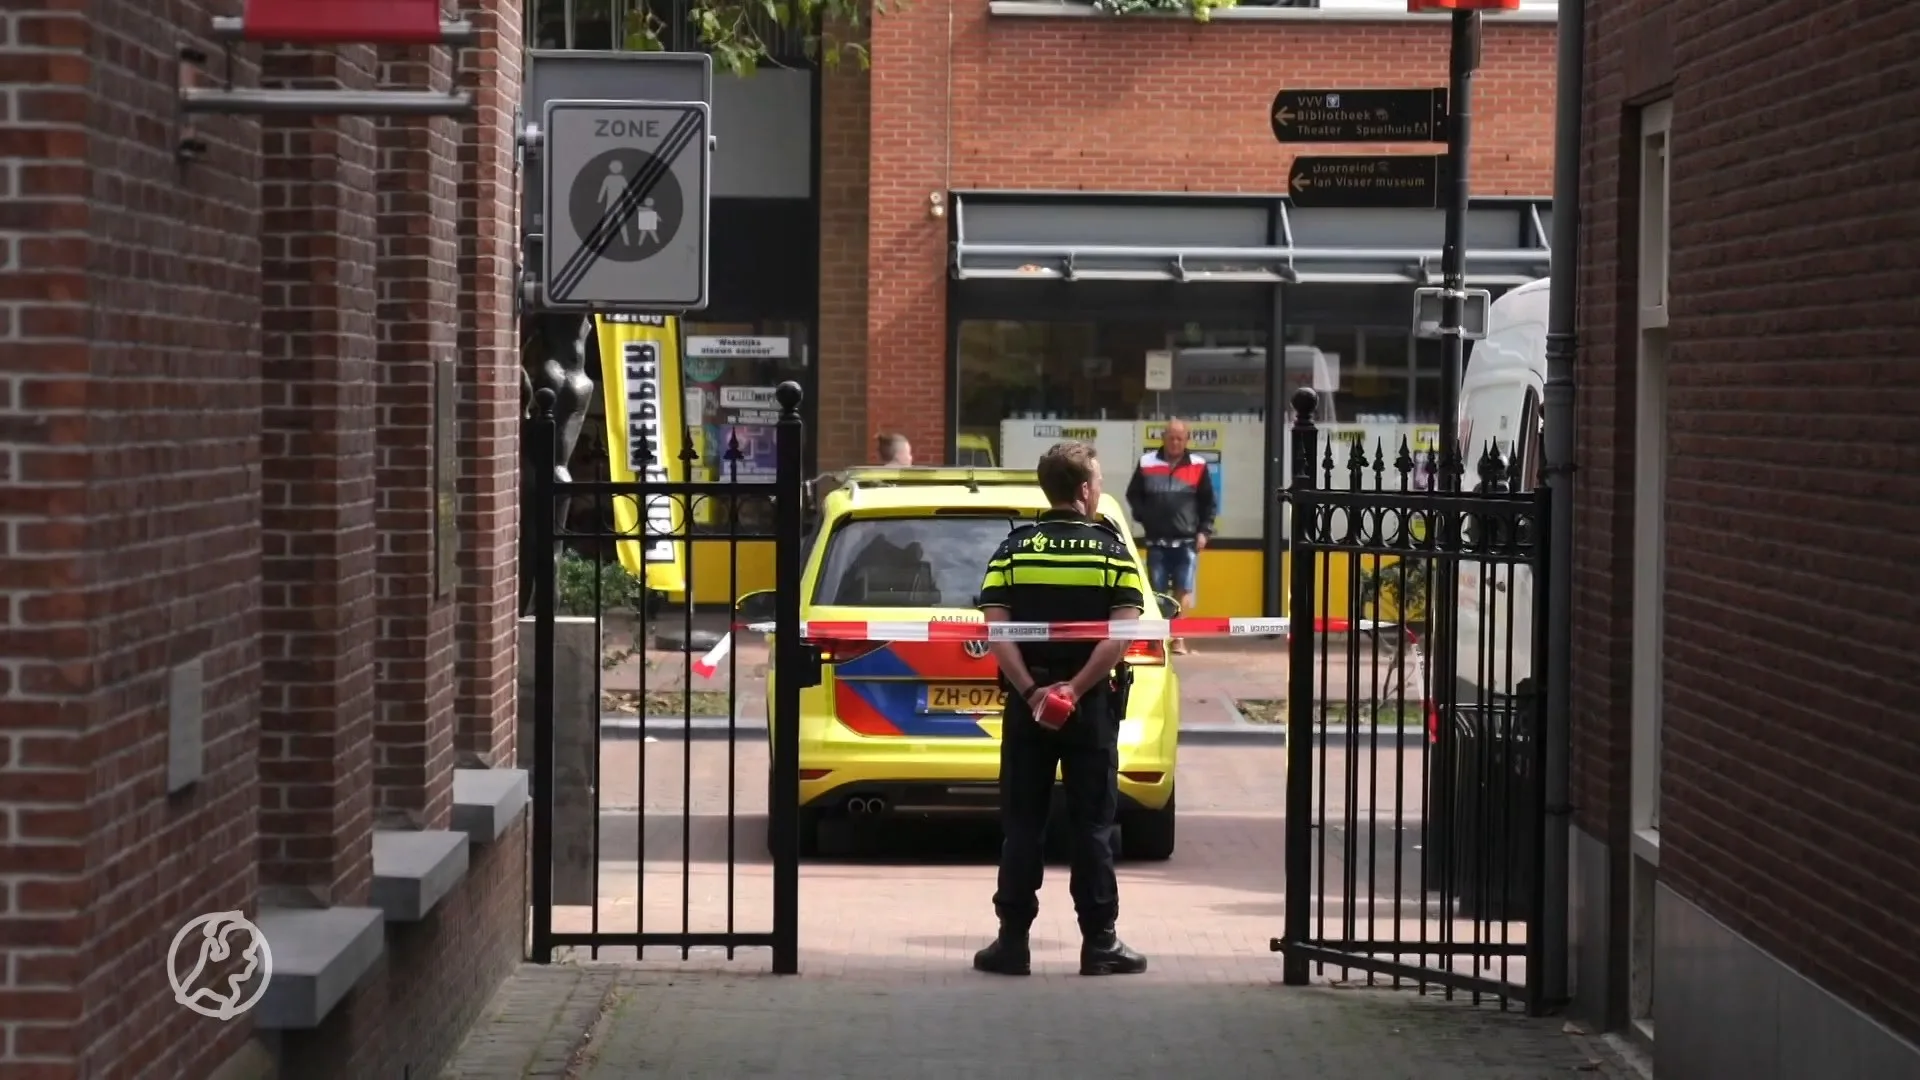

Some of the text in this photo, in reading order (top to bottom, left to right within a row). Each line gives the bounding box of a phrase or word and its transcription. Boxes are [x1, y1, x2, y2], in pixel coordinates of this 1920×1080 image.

[1297, 96, 1323, 108] VVV
[1297, 109, 1372, 121] Bibliotheek
[594, 119, 660, 138] ZONE
[1297, 124, 1413, 137] Theater Speelhuis
[1335, 176, 1372, 187] Visser
[1375, 177, 1425, 187] museum
[1022, 535, 1097, 551] POLITIE
